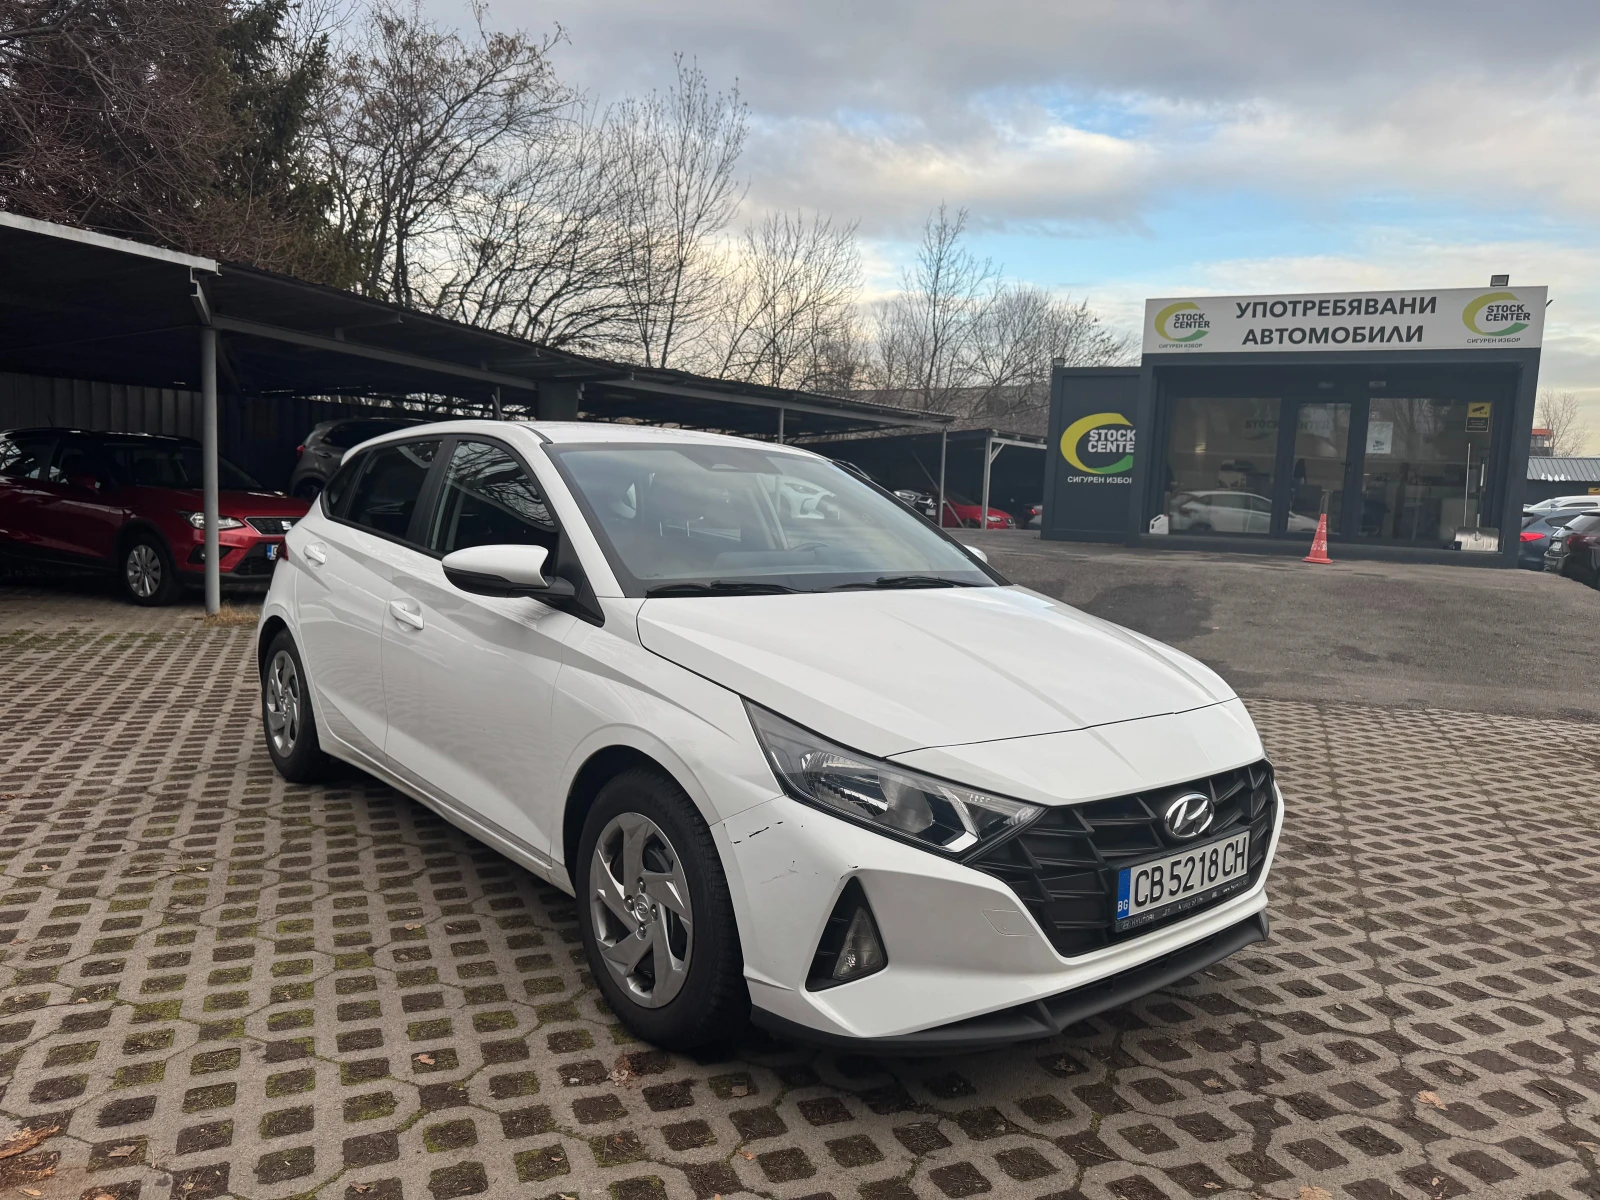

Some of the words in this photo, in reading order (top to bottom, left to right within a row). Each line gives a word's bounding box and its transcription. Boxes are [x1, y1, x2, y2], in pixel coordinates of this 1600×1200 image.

[1235, 297, 1437, 319] УПОТРЕБЯВАНИ
[1487, 304, 1525, 313] STOCK
[1174, 313, 1205, 321] STOCK
[1486, 312, 1531, 322] CENTER
[1173, 320, 1210, 329] CENTER
[1242, 325, 1424, 345] АВТОМОБИЛИ
[1089, 429, 1136, 441] STOCK
[1087, 441, 1135, 453] CENTE
[1067, 476, 1105, 484] СИГУРЕН
[1134, 866, 1164, 907] CB
[1169, 848, 1219, 896] 5218
[1222, 837, 1247, 877] CH
[1117, 899, 1129, 912] BG
